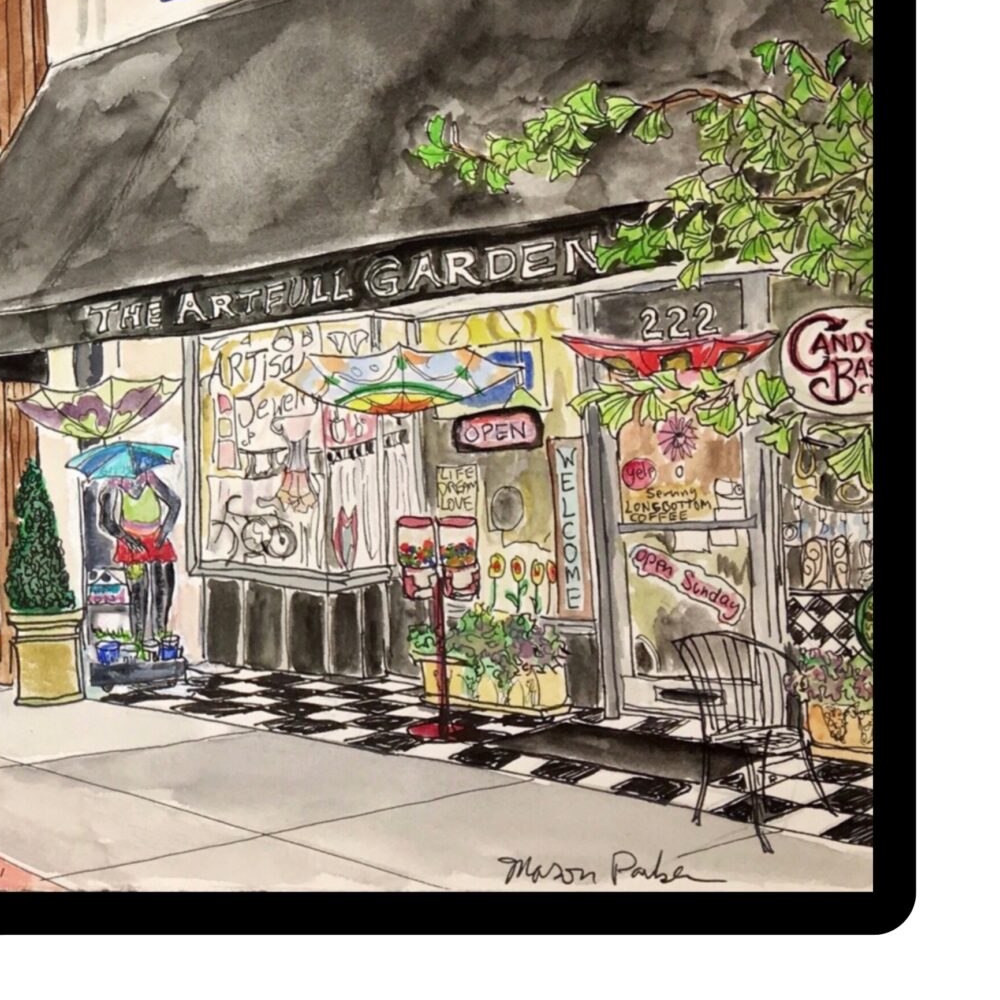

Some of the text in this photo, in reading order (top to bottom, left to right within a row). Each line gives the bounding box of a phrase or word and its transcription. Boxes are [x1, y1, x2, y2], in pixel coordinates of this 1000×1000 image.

[84, 231, 600, 335] THE ARTFULL GARDEN
[639, 301, 720, 341] 222
[463, 420, 526, 443] OPEN
[439, 465, 475, 481] LIFE
[440, 496, 473, 512] LOVE
[629, 510, 689, 523] COFFEE
[556, 446, 581, 610] WELCOME
[680, 568, 741, 621] Sunday
[497, 855, 597, 885] Mason
